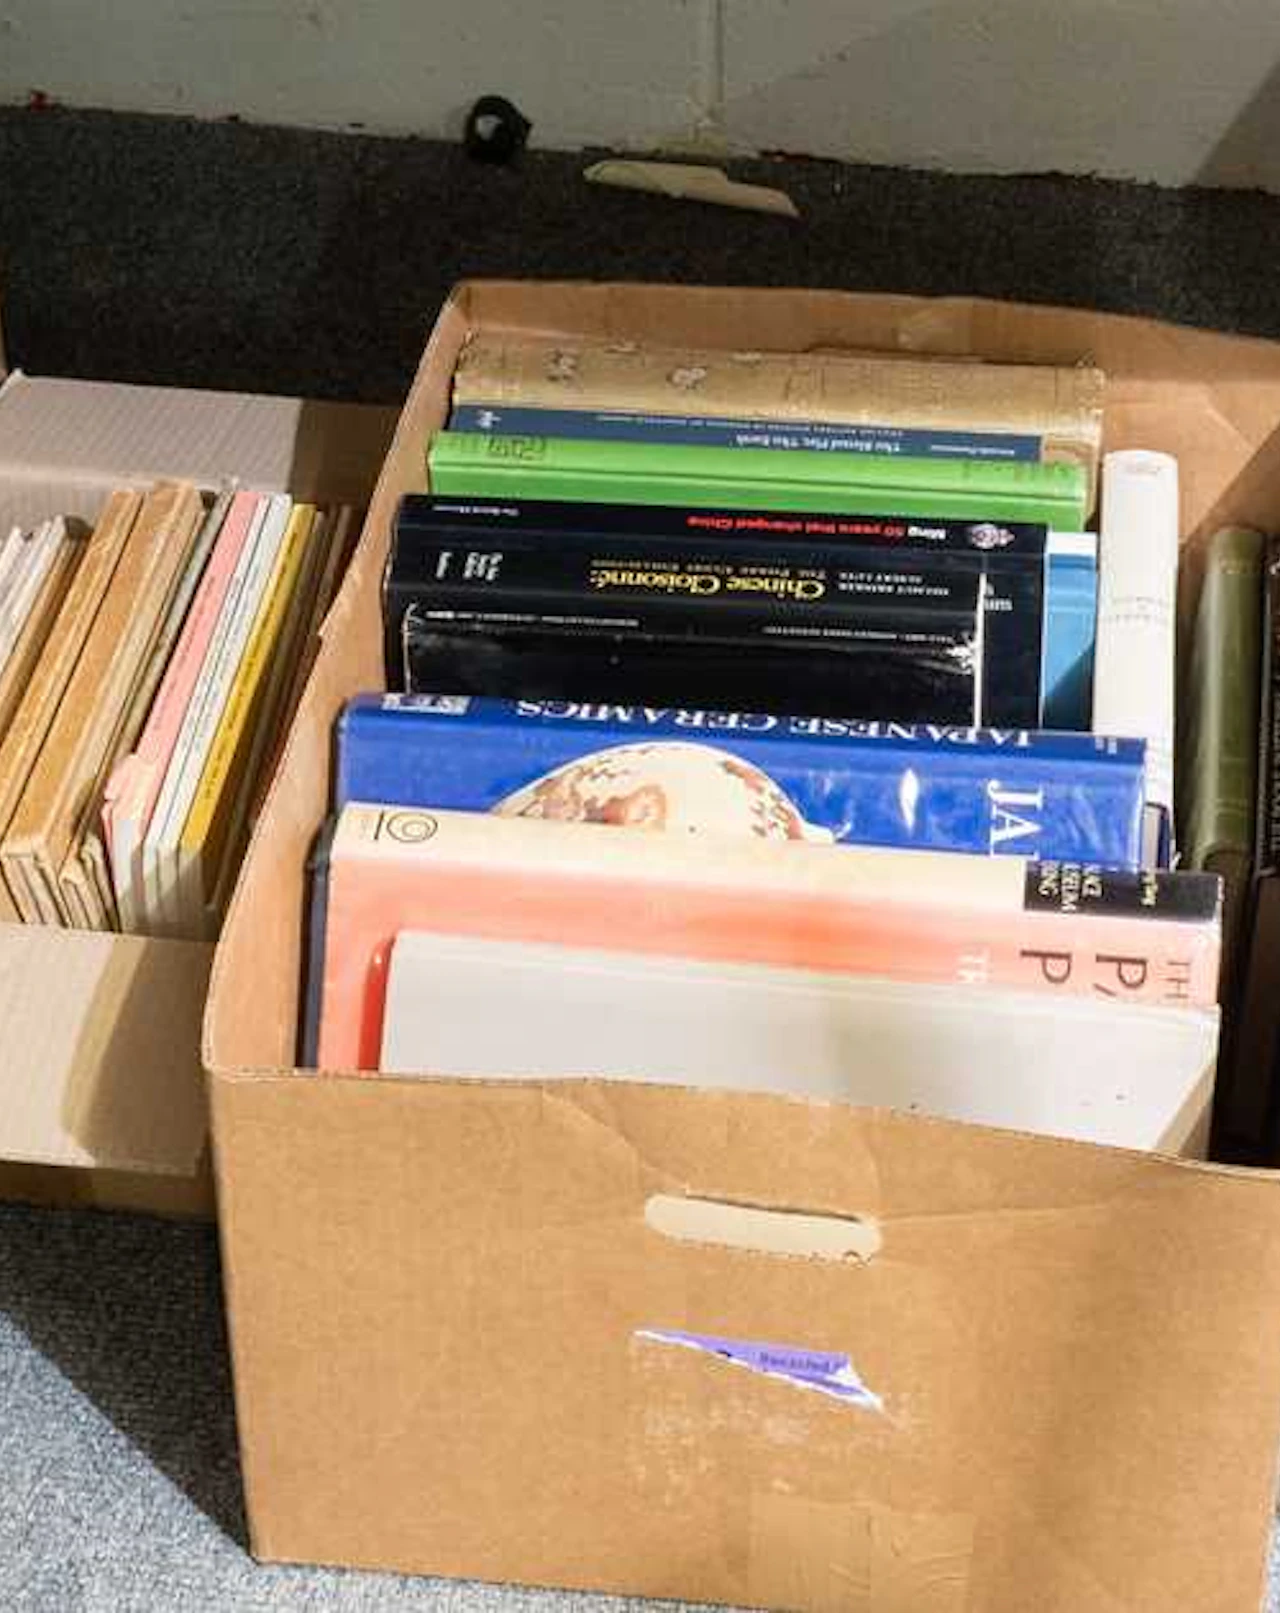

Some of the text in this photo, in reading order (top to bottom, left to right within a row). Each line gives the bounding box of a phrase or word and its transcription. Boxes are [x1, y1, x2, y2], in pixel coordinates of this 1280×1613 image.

[736, 518, 804, 534] changed
[838, 523, 883, 536] years
[907, 526, 946, 541] Ming
[725, 574, 826, 600] Chinese
[516, 698, 1035, 748] JAPANESE CERAMICS
[986, 778, 1044, 860] JA
